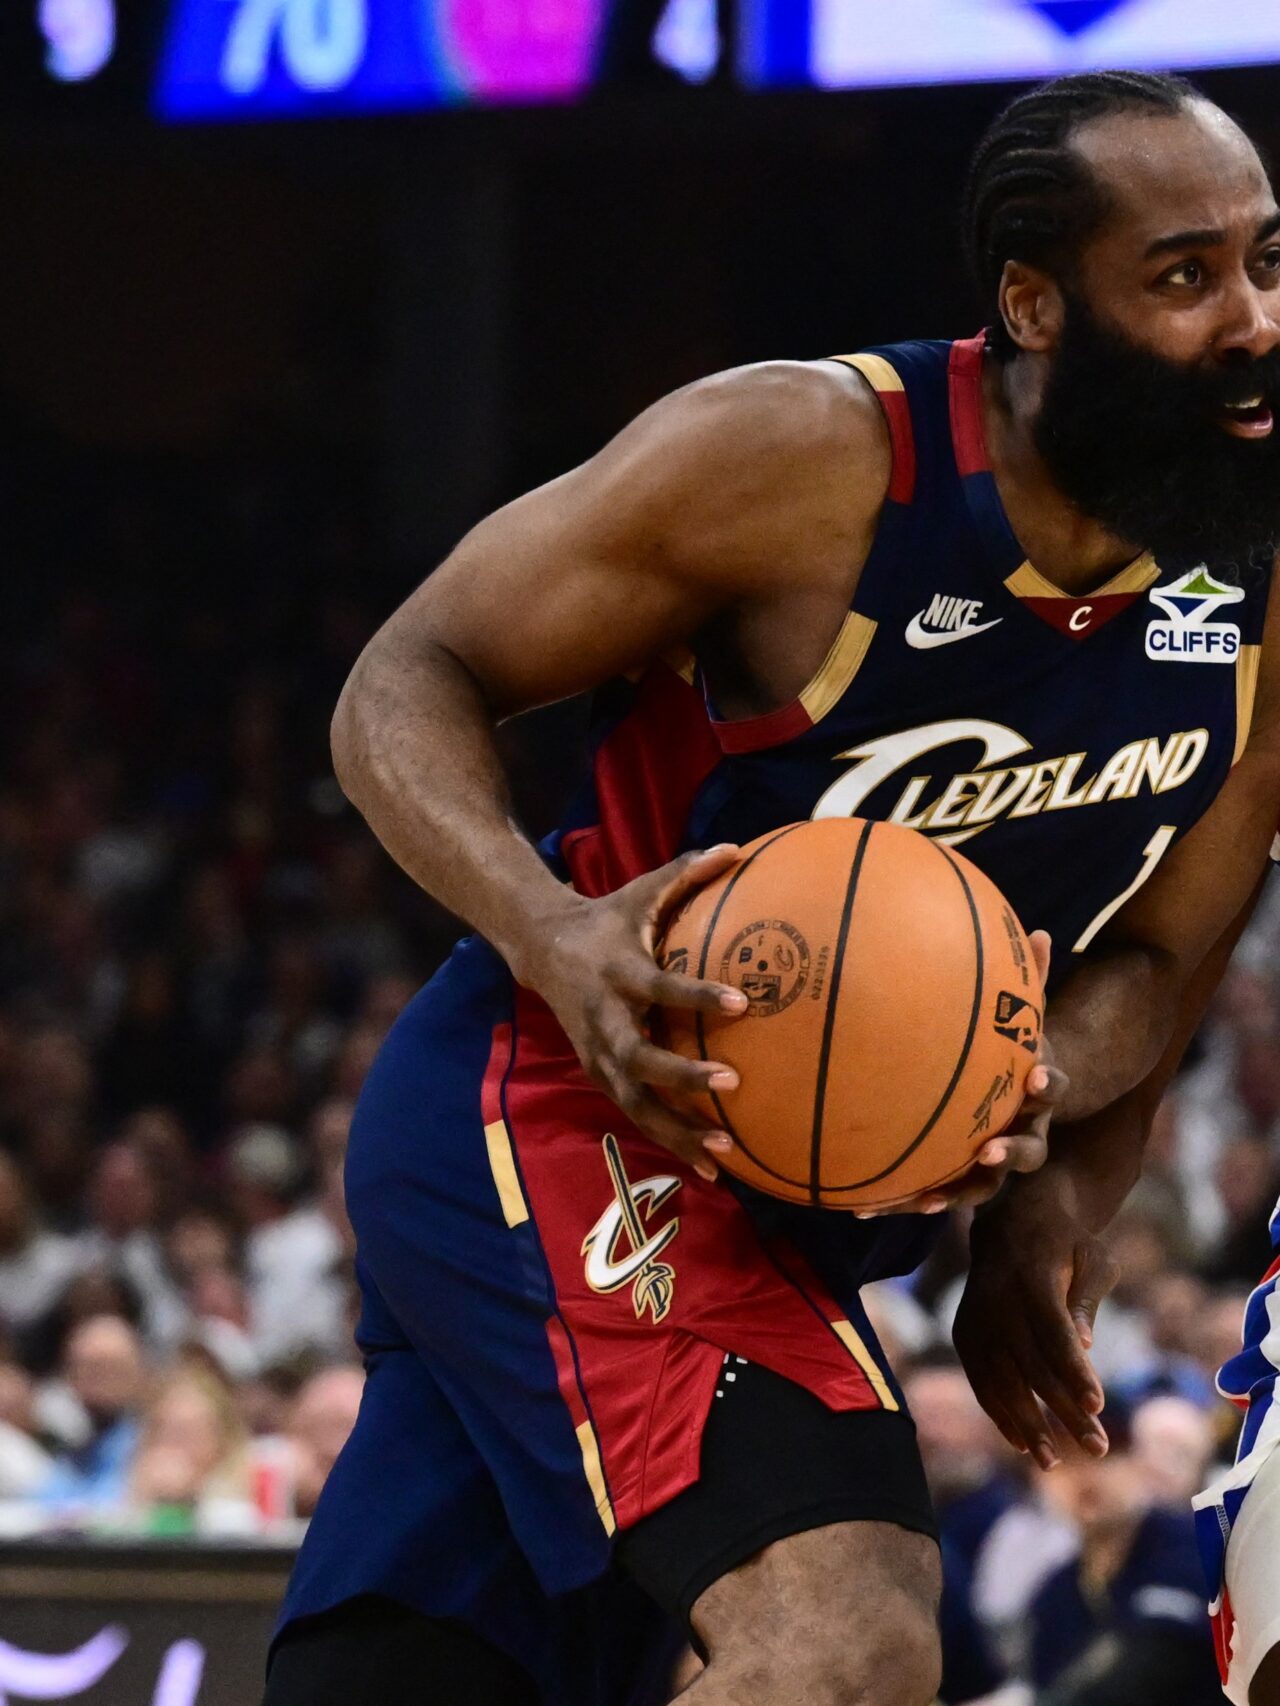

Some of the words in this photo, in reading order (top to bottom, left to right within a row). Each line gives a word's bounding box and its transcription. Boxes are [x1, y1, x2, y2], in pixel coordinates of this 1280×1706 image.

[923, 593, 983, 630] NIKE
[1068, 606, 1092, 631] C
[1149, 628, 1237, 655] CLIFFS
[810, 718, 1210, 847] CLEVELAND
